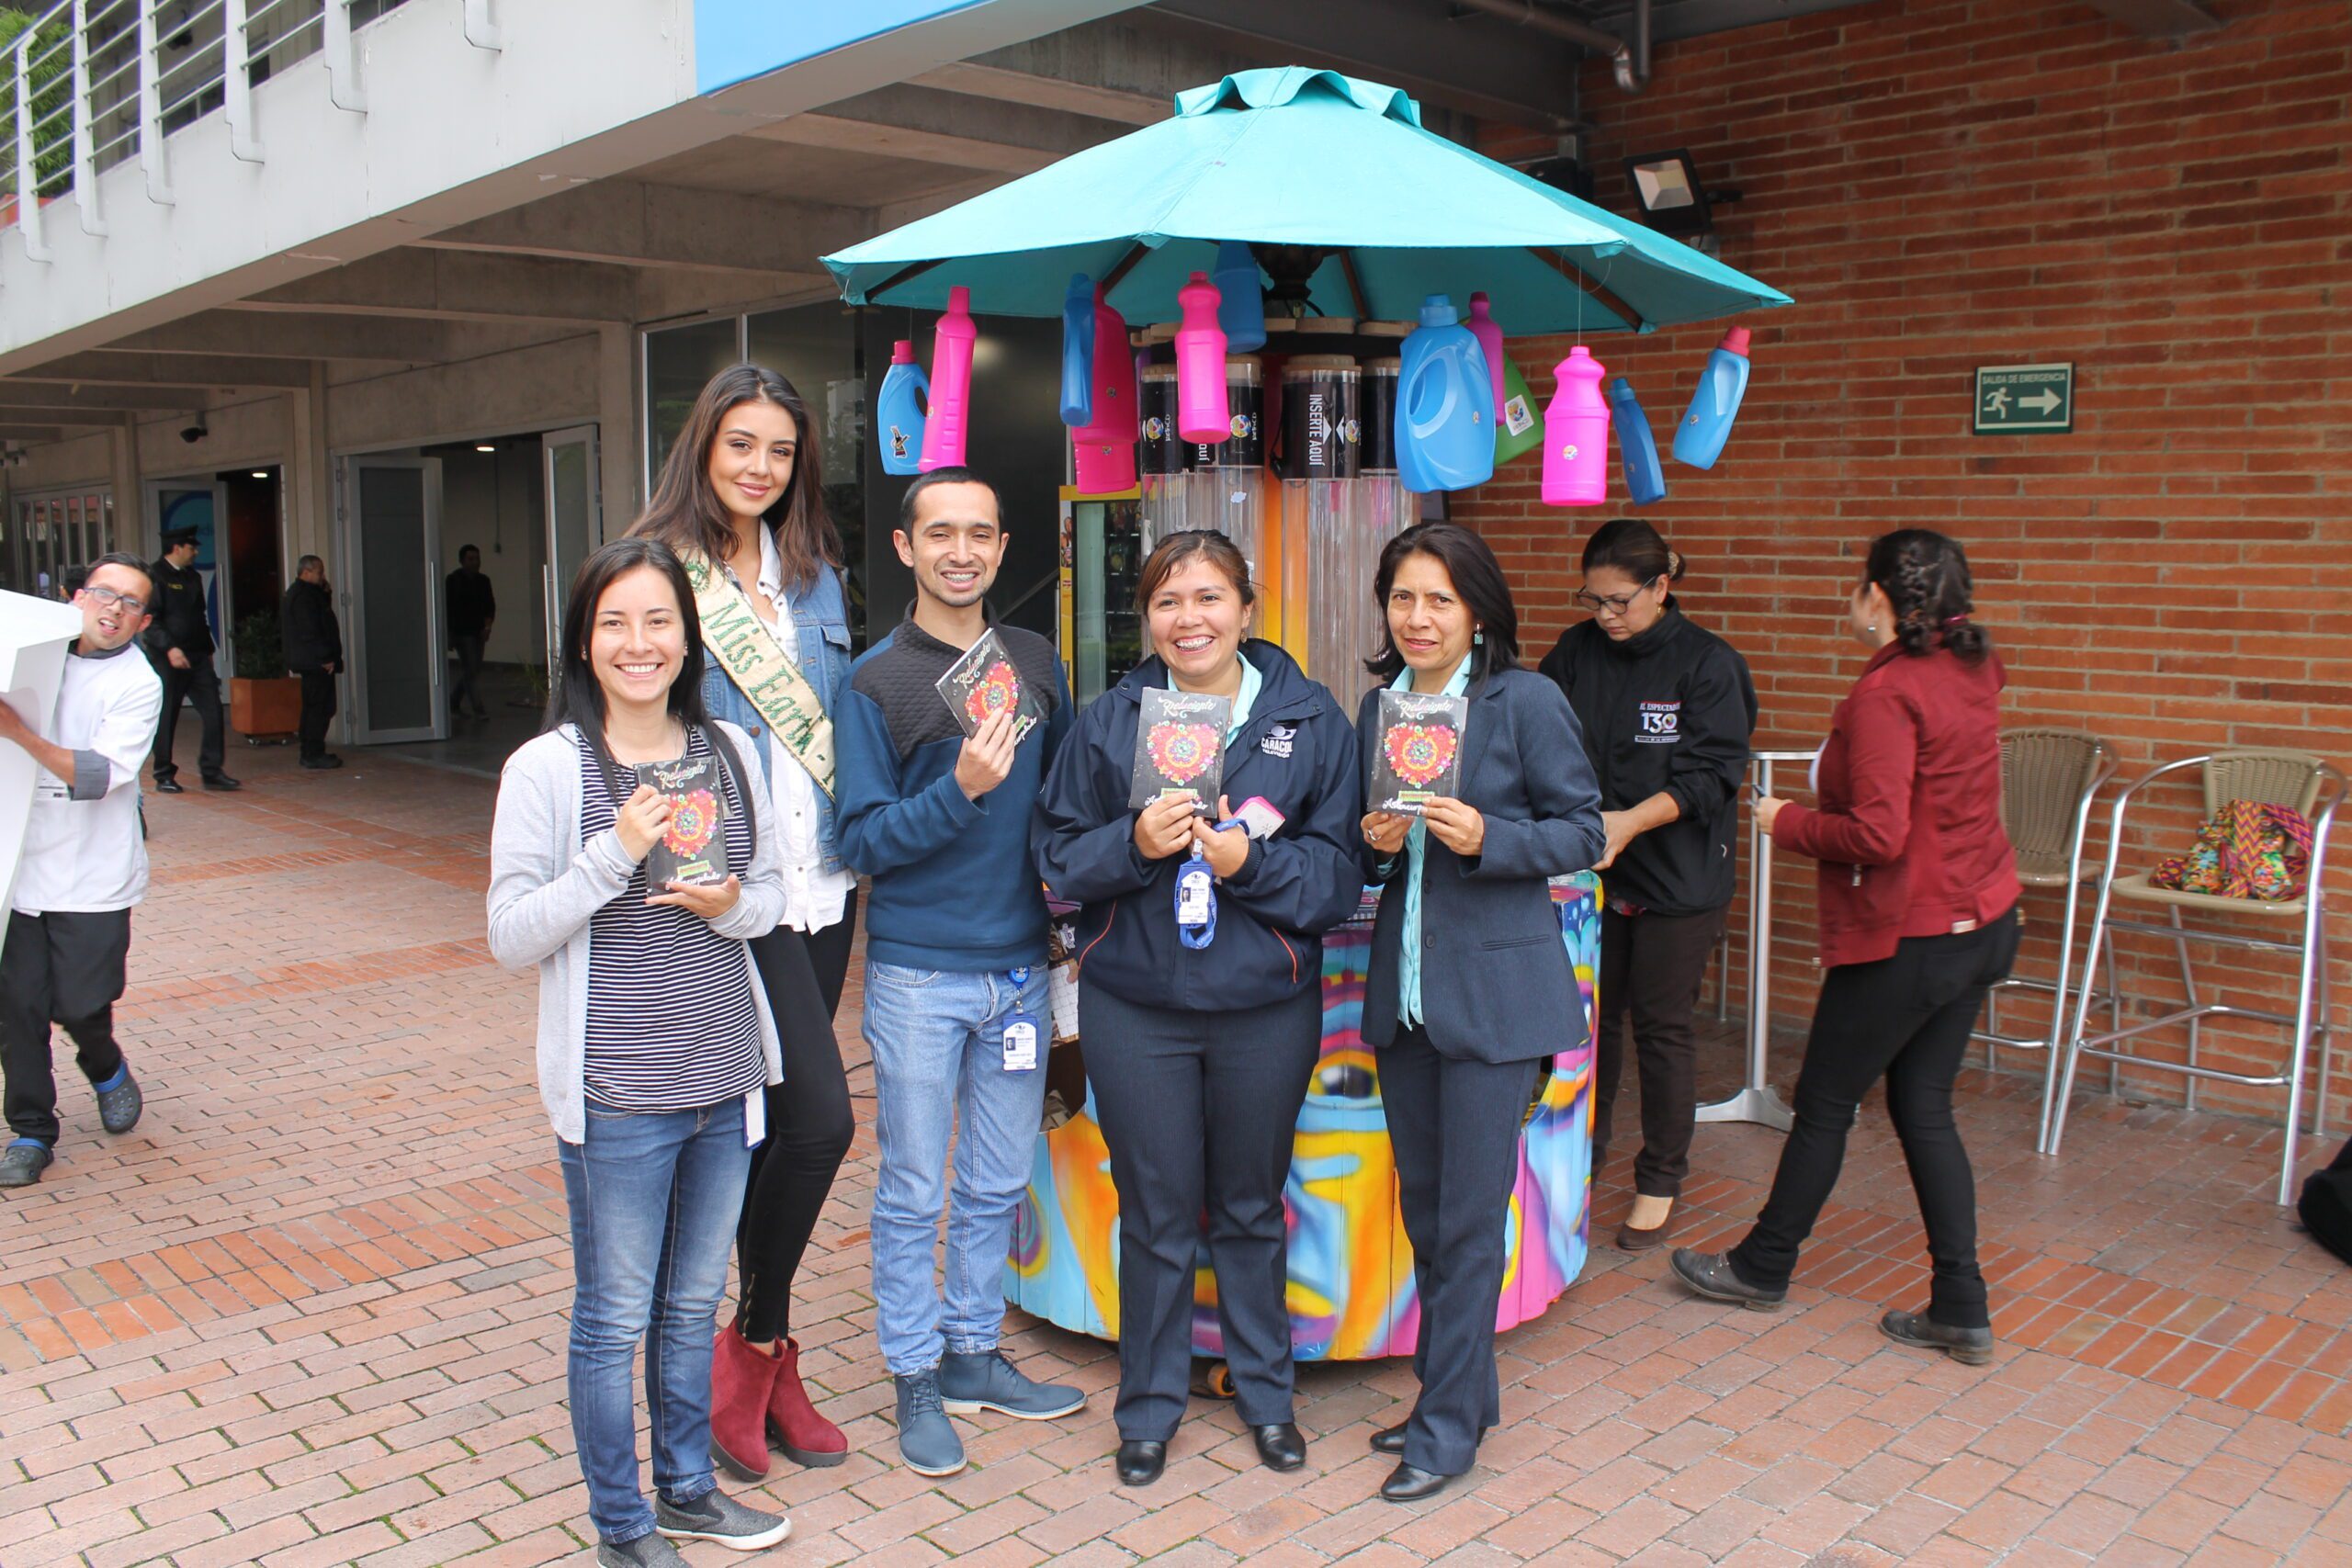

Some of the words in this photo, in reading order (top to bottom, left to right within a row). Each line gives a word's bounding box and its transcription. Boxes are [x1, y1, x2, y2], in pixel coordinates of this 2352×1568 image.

[1983, 375, 2007, 384] SALIDA
[2008, 375, 2018, 383] DE
[2019, 373, 2066, 383] EMERGENCIA
[1309, 394, 1323, 437] INSERTE
[1308, 440, 1325, 466] AQUÍ
[700, 599, 764, 674] Miss
[748, 664, 815, 756] Earth
[1261, 738, 1293, 753] CARACOL
